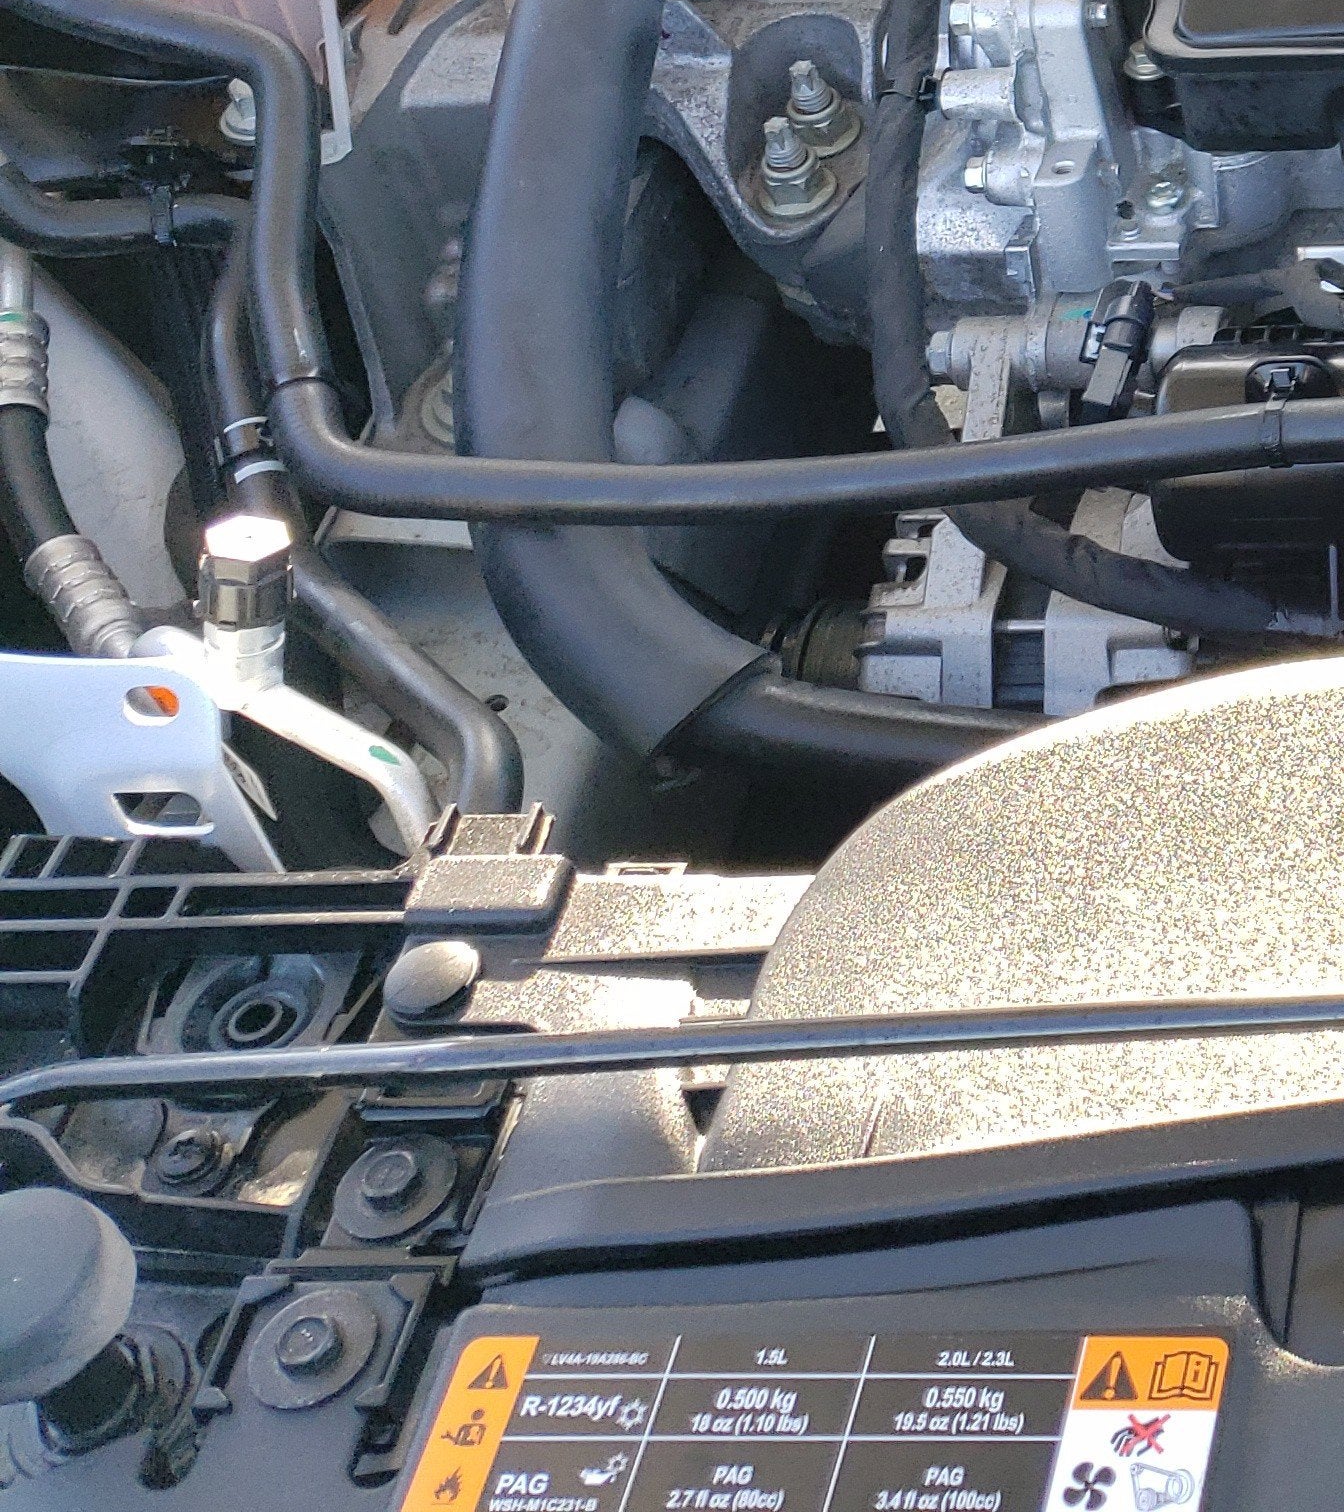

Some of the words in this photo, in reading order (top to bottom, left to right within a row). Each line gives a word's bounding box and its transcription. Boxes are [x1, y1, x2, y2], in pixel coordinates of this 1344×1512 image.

[755, 1347, 789, 1366] 1.5L
[936, 1351, 971, 1366] 2.0L
[981, 1351, 1015, 1366] 2.3L
[519, 1393, 624, 1422] R-1234yf
[715, 1388, 767, 1410] 0.500
[770, 1388, 799, 1414] kg
[924, 1386, 976, 1409] 0.550
[978, 1386, 1005, 1413] kg
[691, 1413, 712, 1433] 18
[711, 1418, 734, 1433] oz
[735, 1413, 776, 1436] (1.10
[777, 1413, 810, 1436] lbs)
[893, 1412, 929, 1431] 19.5
[928, 1416, 951, 1431] oz
[951, 1412, 993, 1434] (1.21
[993, 1412, 1026, 1435] lbs)
[494, 1472, 551, 1495] PAG
[712, 1465, 755, 1485] PAG
[923, 1465, 966, 1486] PAG
[665, 1489, 694, 1510] 2.7
[708, 1493, 731, 1509] oz
[731, 1489, 786, 1512] (80cc)
[874, 1489, 902, 1510] 3.4
[918, 1494, 941, 1510] oz
[940, 1488, 1003, 1512] (100cc)
